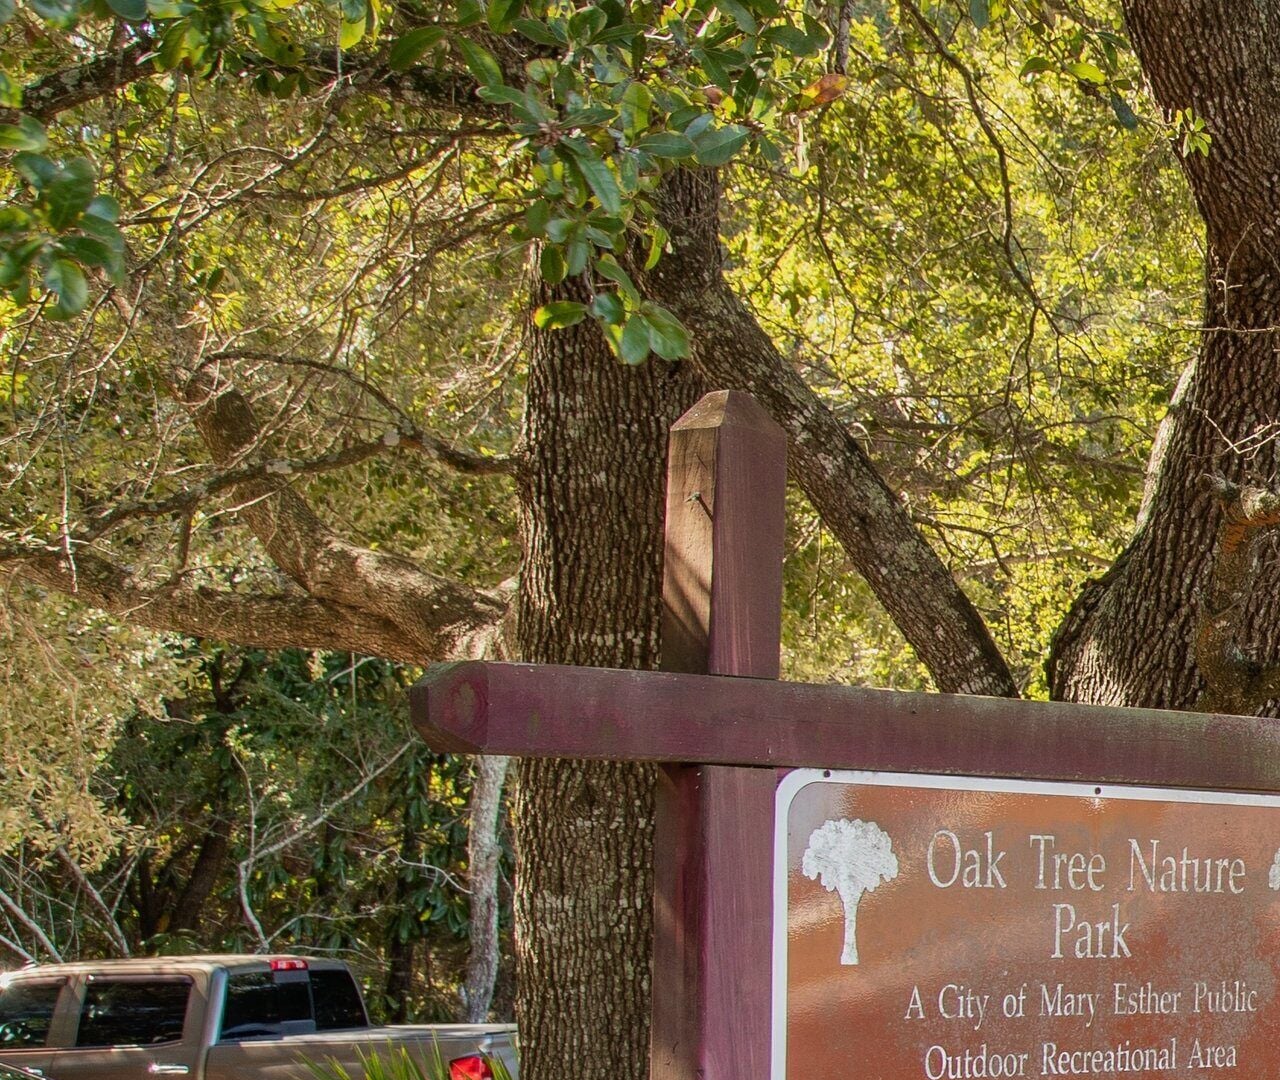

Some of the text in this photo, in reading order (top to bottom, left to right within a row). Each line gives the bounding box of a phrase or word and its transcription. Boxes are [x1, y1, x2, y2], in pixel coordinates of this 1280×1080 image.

[926, 830, 1246, 895] Oak Tree Nature
[1051, 903, 1132, 960] Park
[905, 981, 1258, 1030] A City of Mary Esther Public
[925, 1037, 1237, 1080] Outdoor Recreational Area
